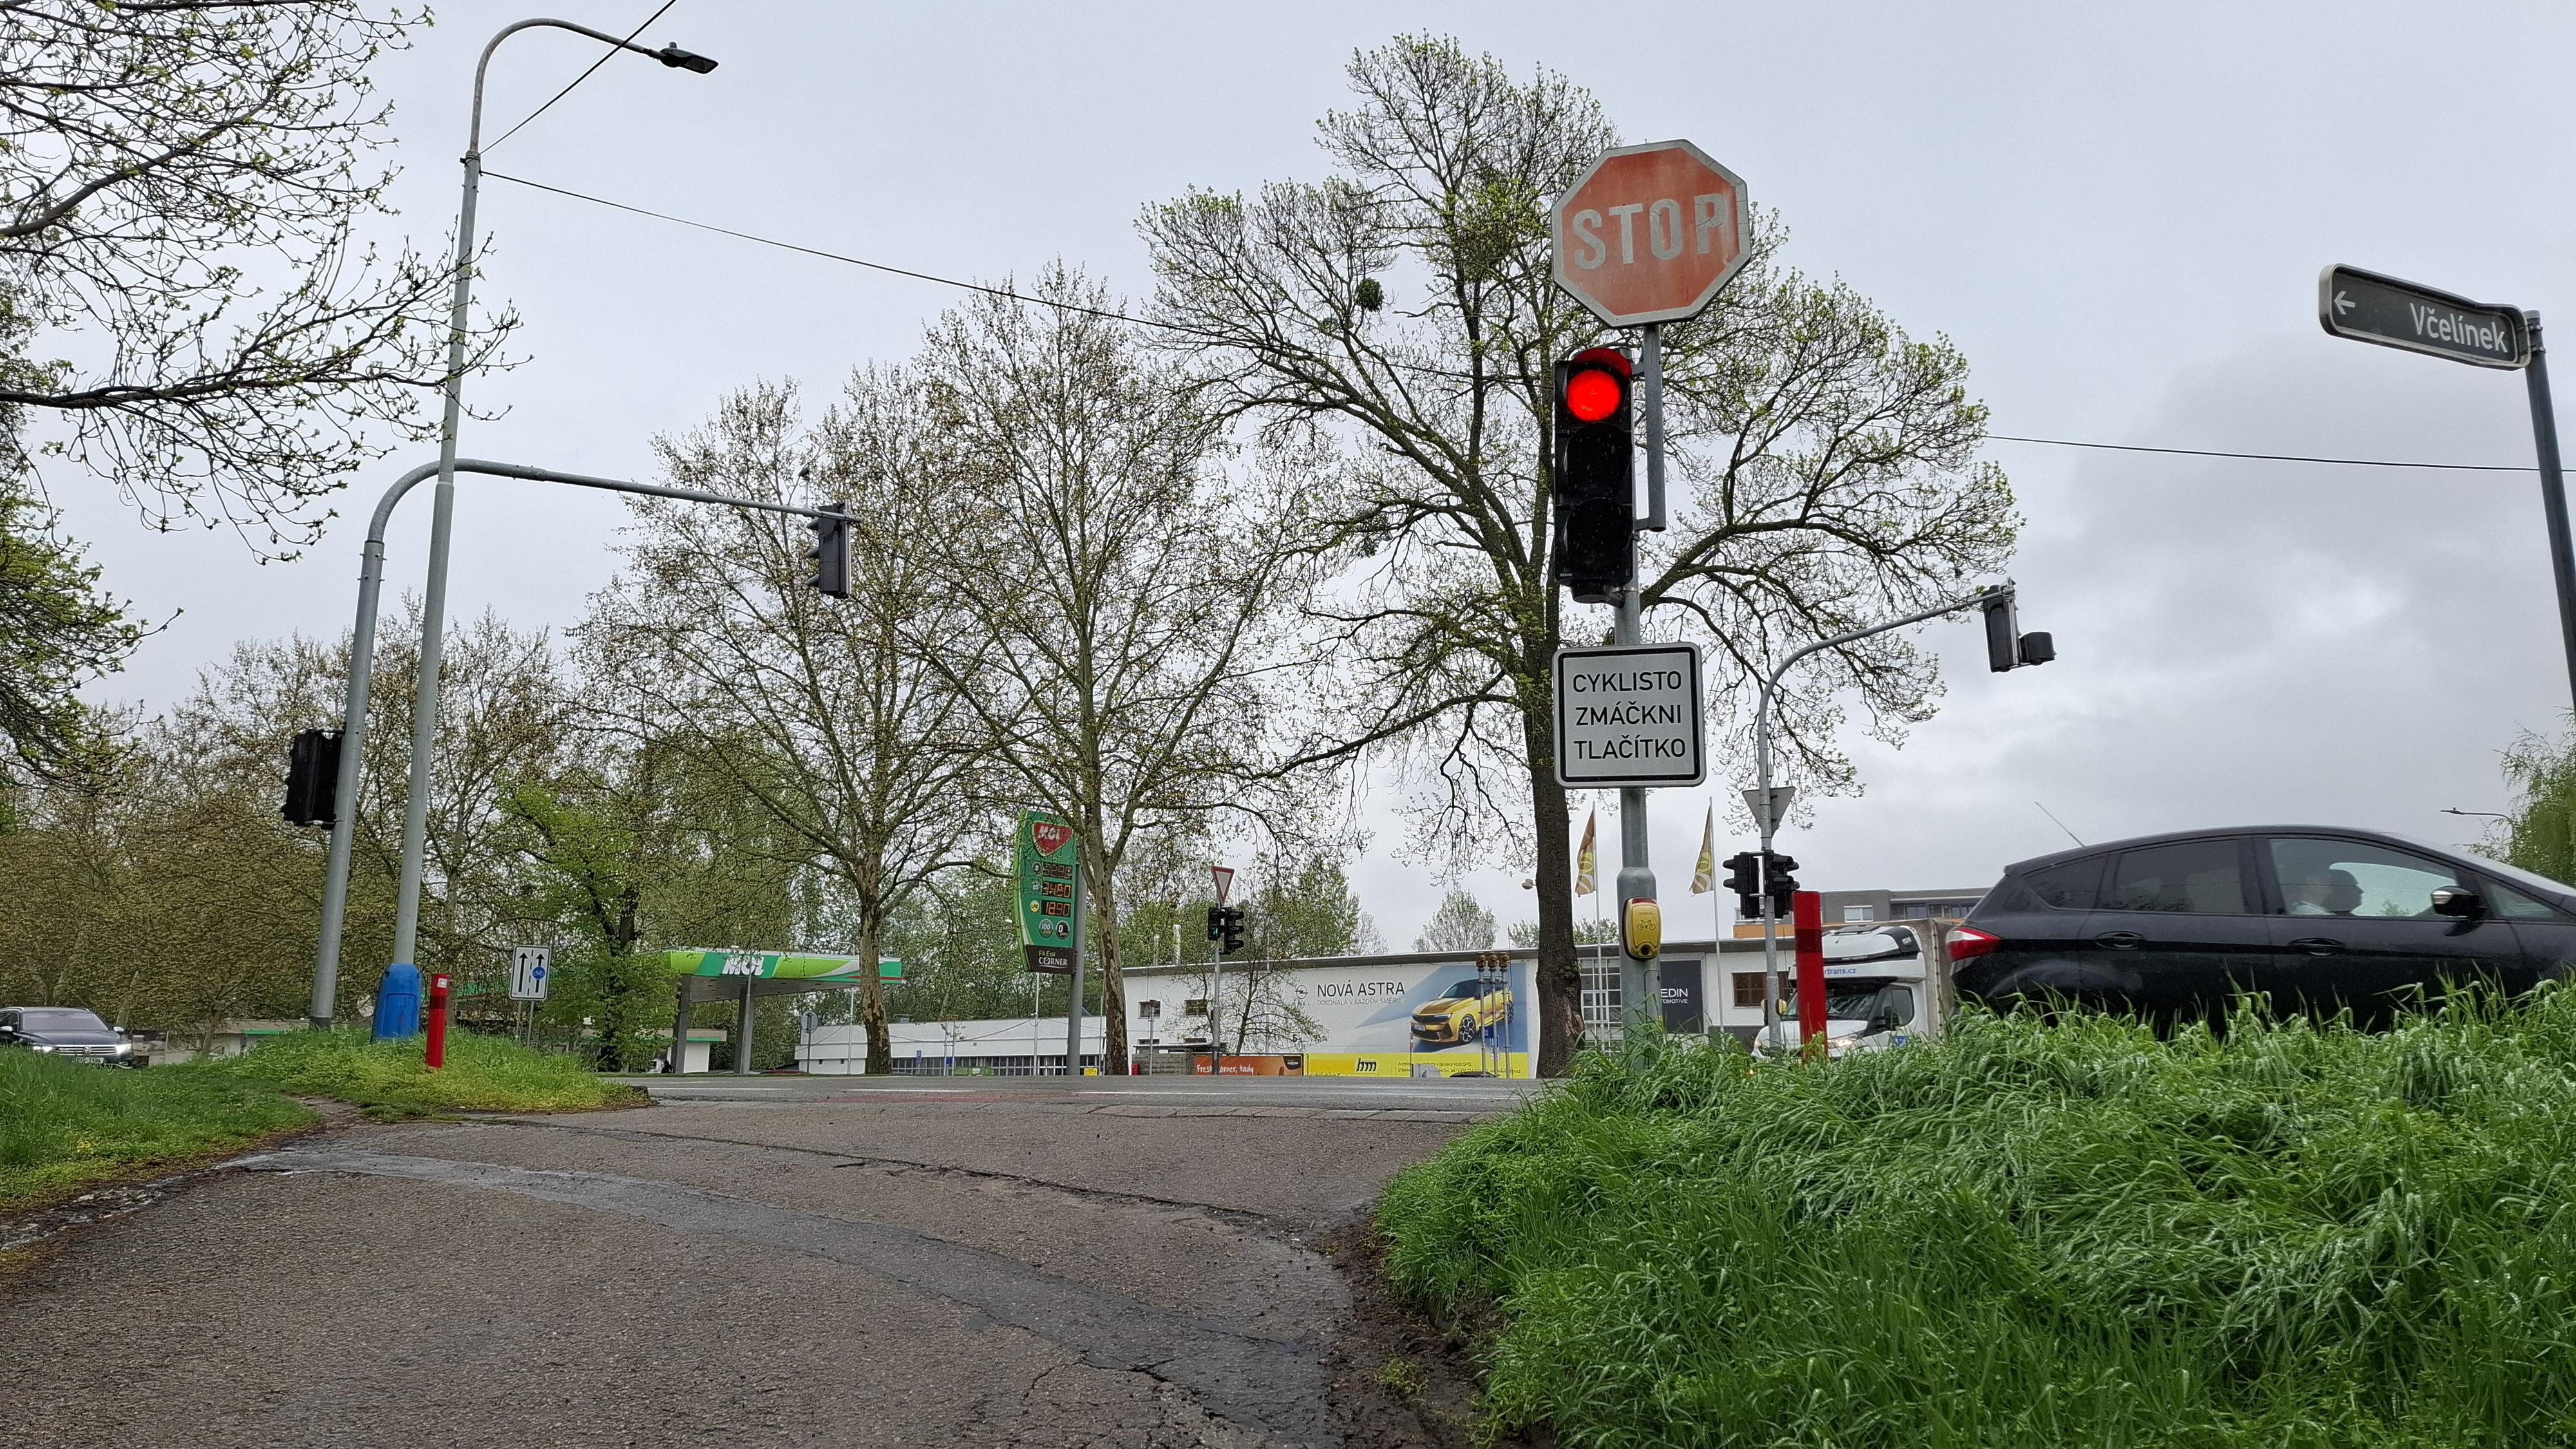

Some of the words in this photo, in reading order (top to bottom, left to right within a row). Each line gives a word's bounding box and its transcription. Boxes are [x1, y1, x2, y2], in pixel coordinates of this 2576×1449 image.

[1573, 194, 1732, 270] STOP
[2409, 303, 2508, 353] Včelínek
[1573, 671, 1681, 693] CYKLISTO
[1575, 701, 1681, 726] ZMÁČKNI
[1573, 735, 1686, 759] TLAČÍTKO
[722, 955, 764, 976] MOL
[1038, 957, 1068, 966] CORNER
[1318, 980, 1354, 997] NOVÁ
[1358, 982, 1405, 996] ASTRA
[1661, 989, 1688, 998] EDIN
[1219, 1065, 1237, 1074] orner,
[1240, 1064, 1254, 1075] tady
[1356, 1057, 1377, 1072] hm
